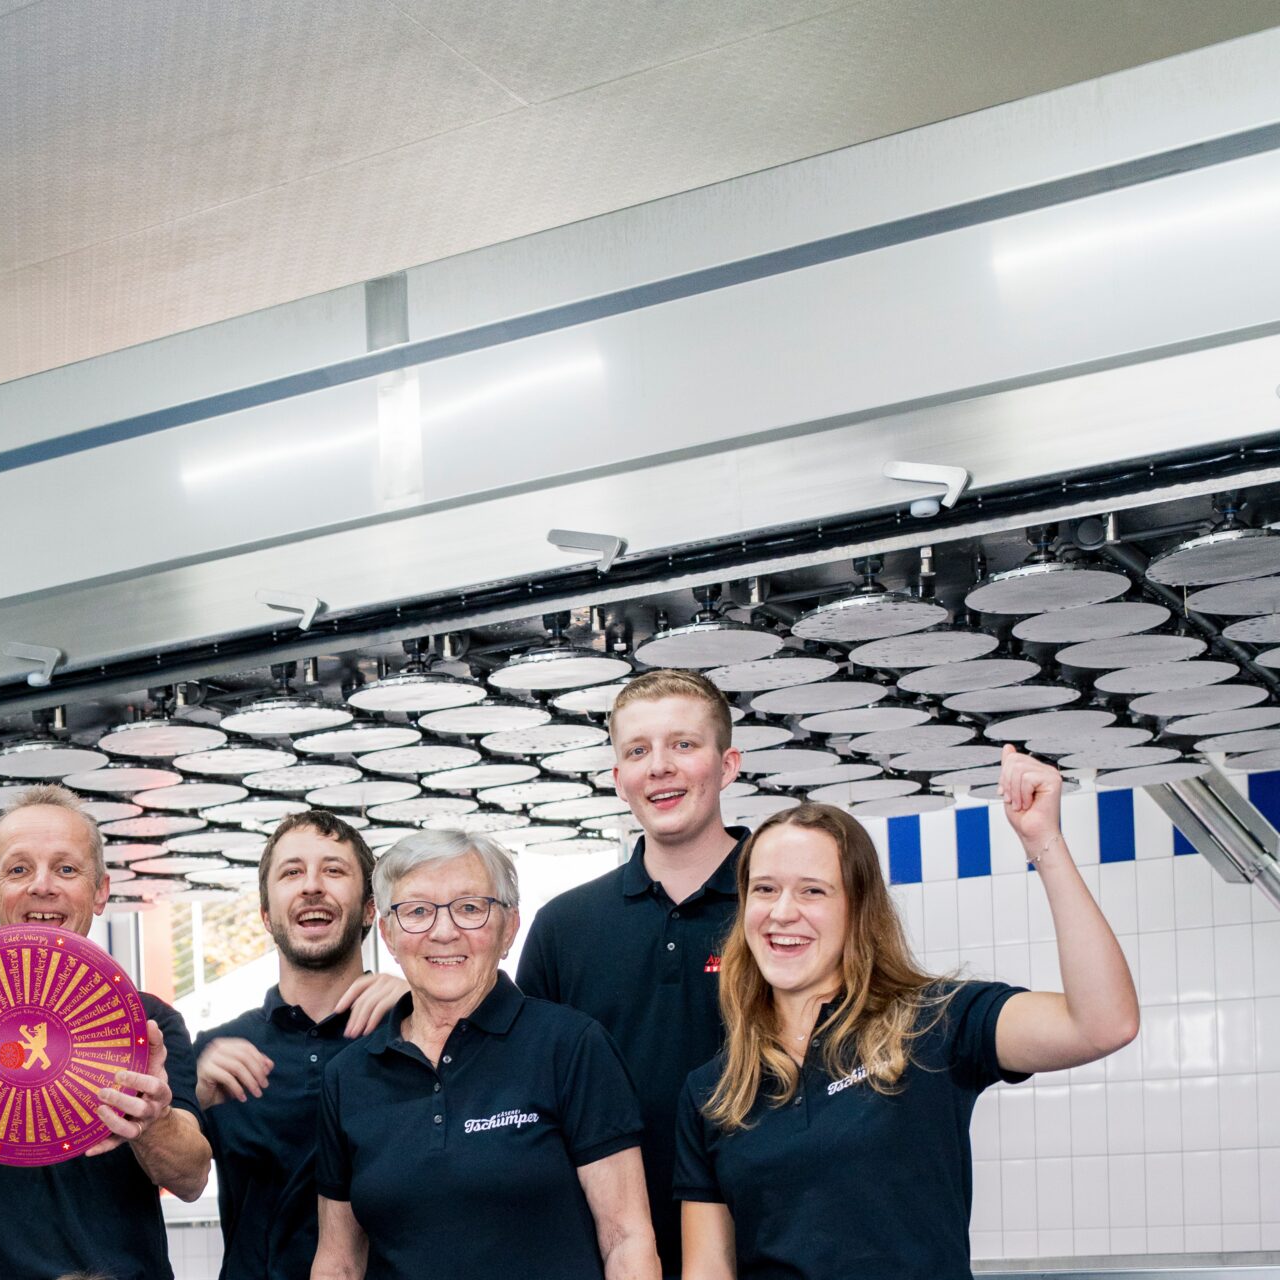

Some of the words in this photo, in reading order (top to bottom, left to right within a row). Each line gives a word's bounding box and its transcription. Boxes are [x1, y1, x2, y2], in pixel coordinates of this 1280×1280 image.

[10, 957, 23, 1004] Appenzeller
[32, 958, 45, 1003] Appenzeller
[46, 966, 72, 1008] Appenzeller
[59, 981, 94, 1014] Appenzeller
[69, 1002, 110, 1026] Appenzeller
[73, 1027, 120, 1041] Appenzeller
[74, 1049, 120, 1067] Appenzeller
[62, 1075, 95, 1108] Appenzeller
[70, 1063, 113, 1092] Appenzeller
[10, 1090, 24, 1135] Appenzeller
[33, 1090, 47, 1134] Appenzeller
[49, 1085, 74, 1126] Appenzeller
[464, 1112, 539, 1134] Tschumper
